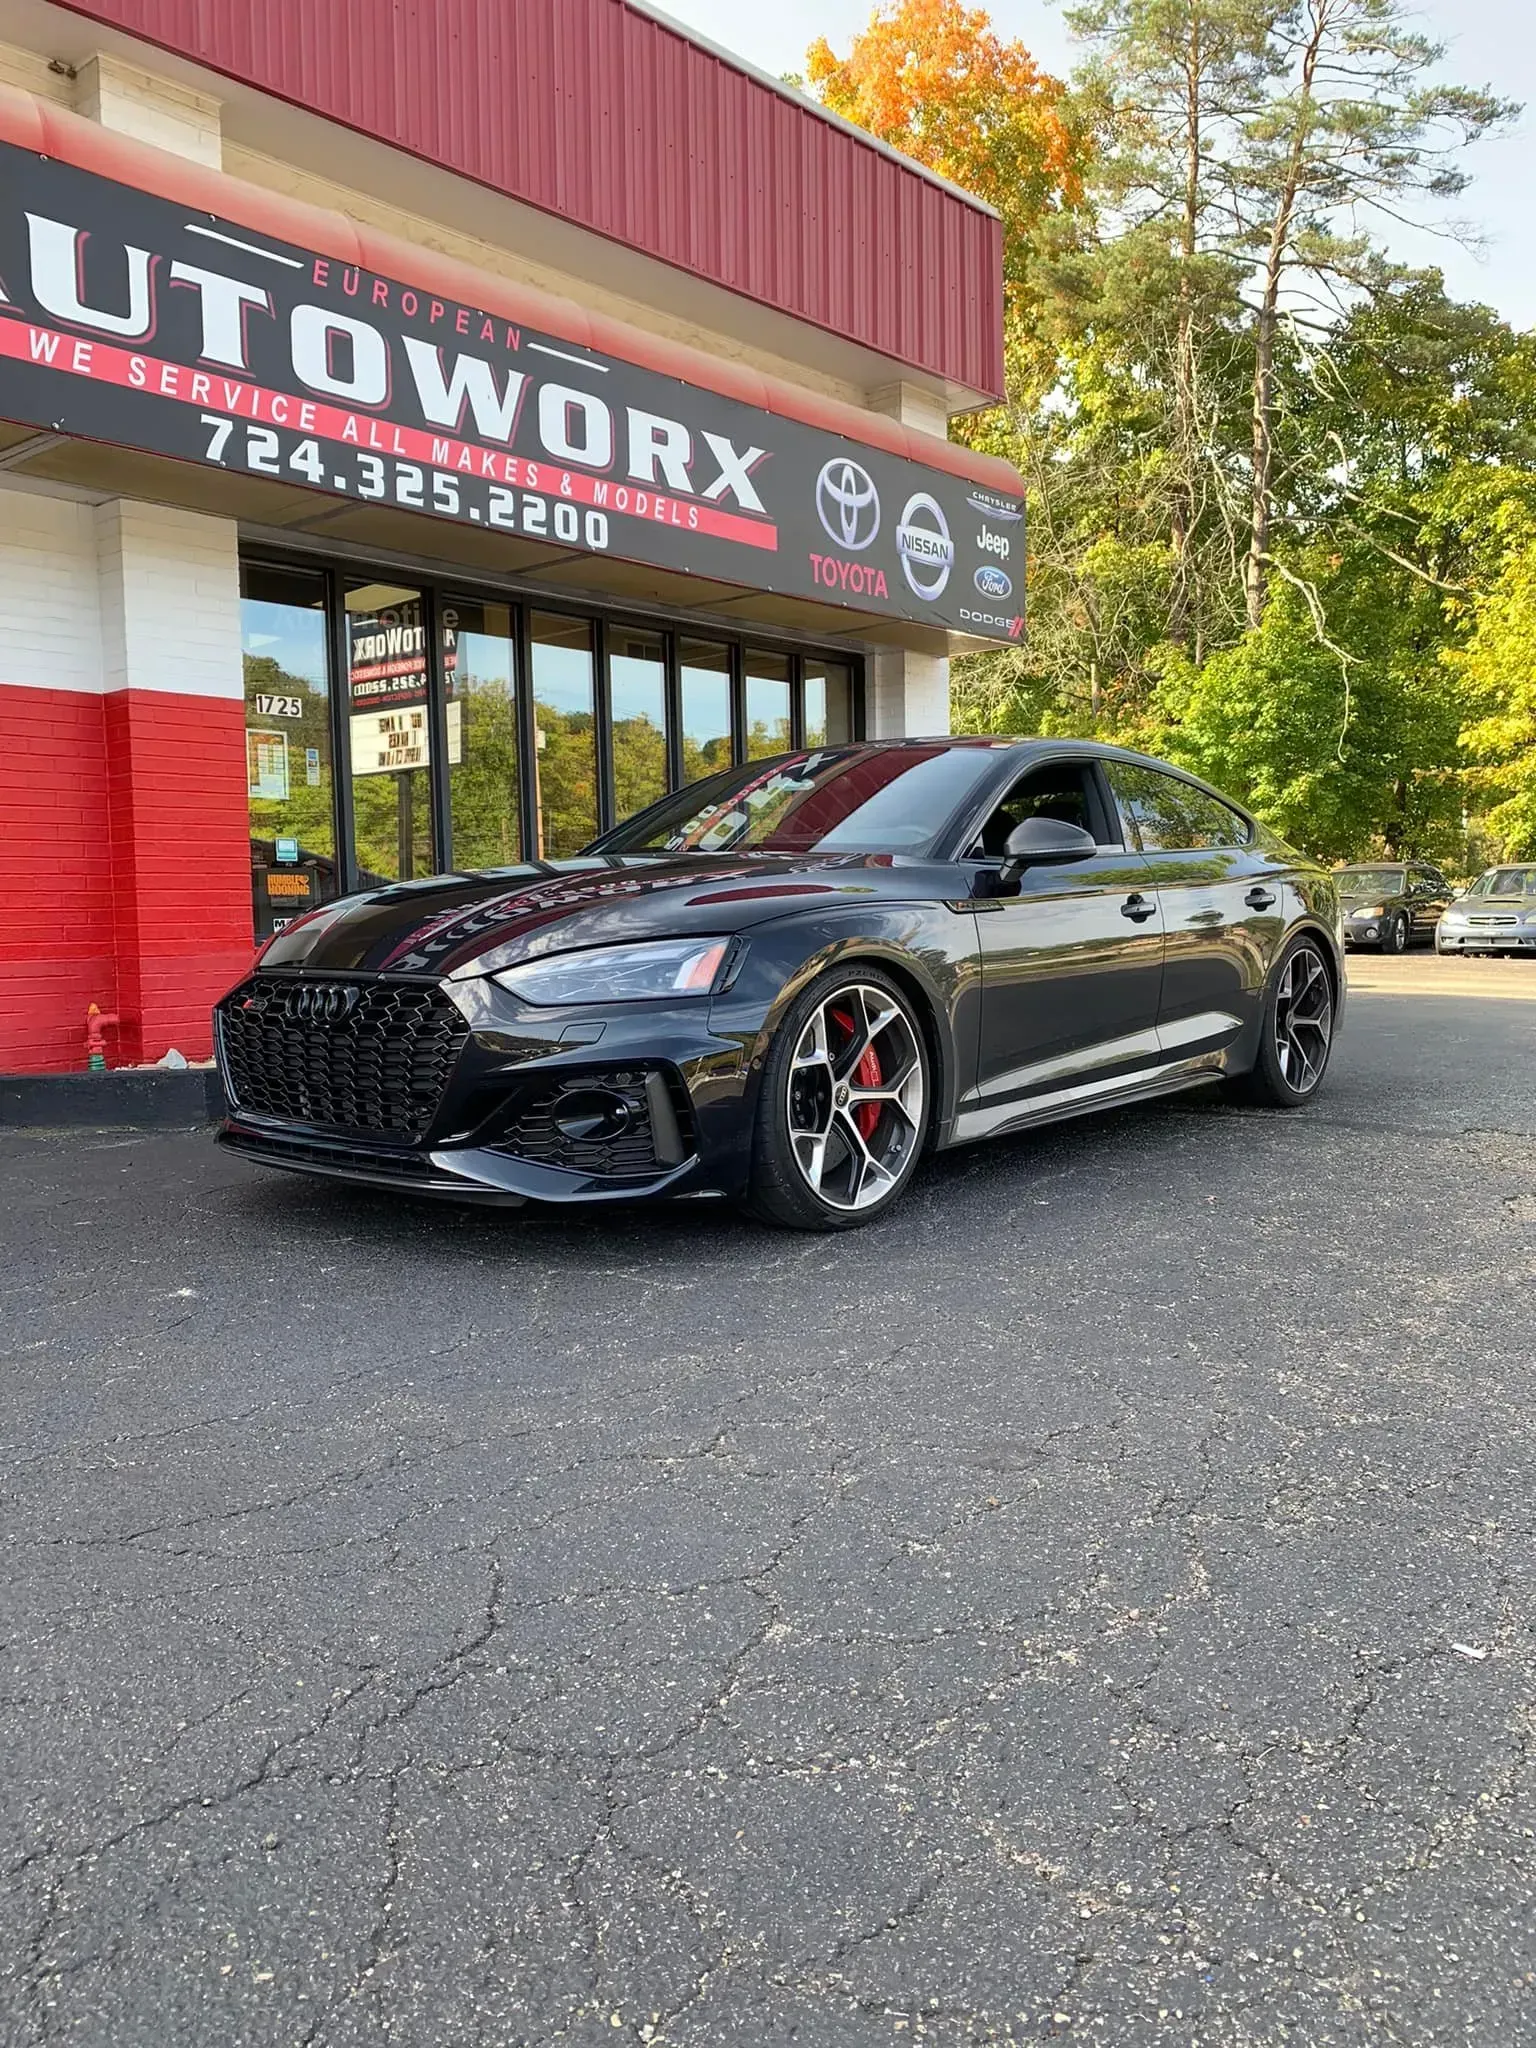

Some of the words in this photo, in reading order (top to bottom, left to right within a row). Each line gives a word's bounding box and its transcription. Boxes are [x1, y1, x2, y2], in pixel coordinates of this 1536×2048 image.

[313, 258, 521, 351] EUROPEAN
[0, 211, 773, 520] UTOWORX
[29, 329, 93, 374] WE
[128, 356, 317, 432] SERVICE
[341, 414, 407, 455] ALL
[432, 438, 538, 488] MAKES
[560, 471, 573, 497] &
[593, 480, 699, 530] MODELS
[200, 414, 609, 550] 724.325.2200
[972, 491, 1017, 513] CHRYSLER
[901, 533, 950, 561] NISSAN
[976, 524, 1011, 561] Jeep
[809, 553, 889, 600] TOYOTA
[982, 571, 1006, 595] Ford
[959, 608, 1015, 630] DODGE
[257, 695, 301, 717] 1725
